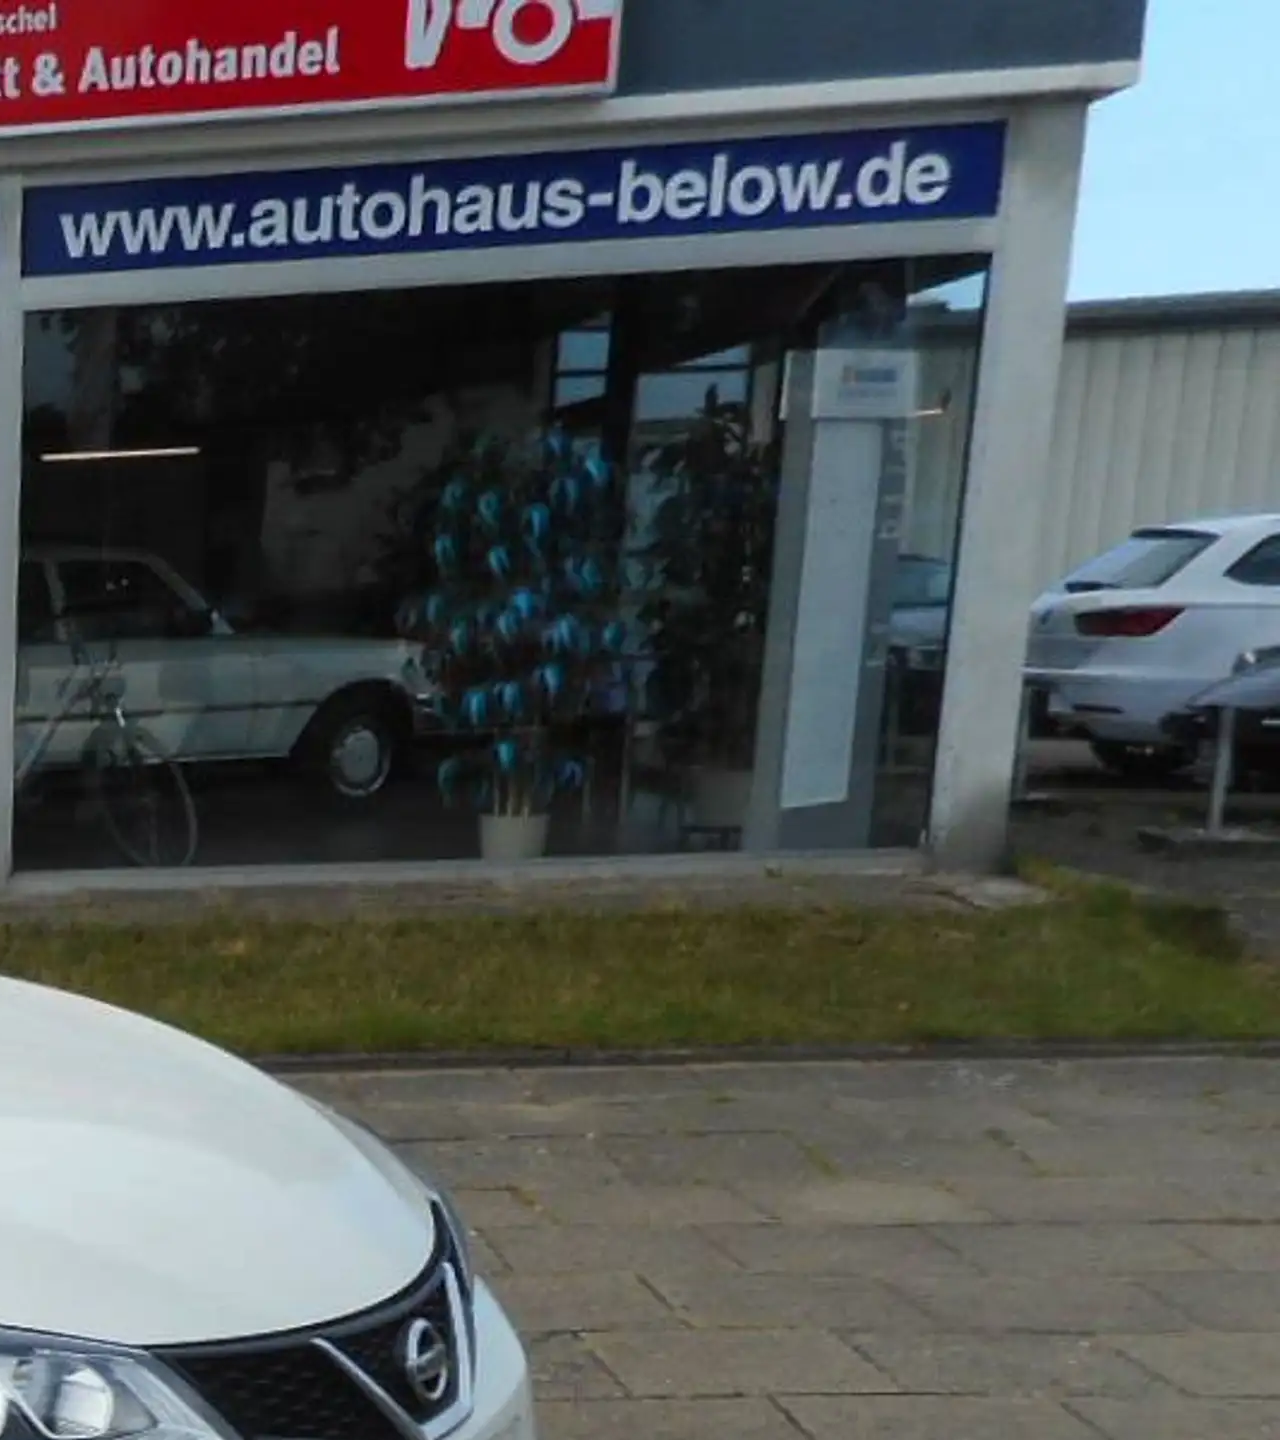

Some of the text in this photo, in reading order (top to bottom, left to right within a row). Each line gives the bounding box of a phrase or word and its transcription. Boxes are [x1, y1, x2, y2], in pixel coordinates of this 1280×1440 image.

[31, 52, 66, 96] &
[77, 26, 341, 94] Autohandel
[60, 141, 953, 258] www.autohaus-below.de
